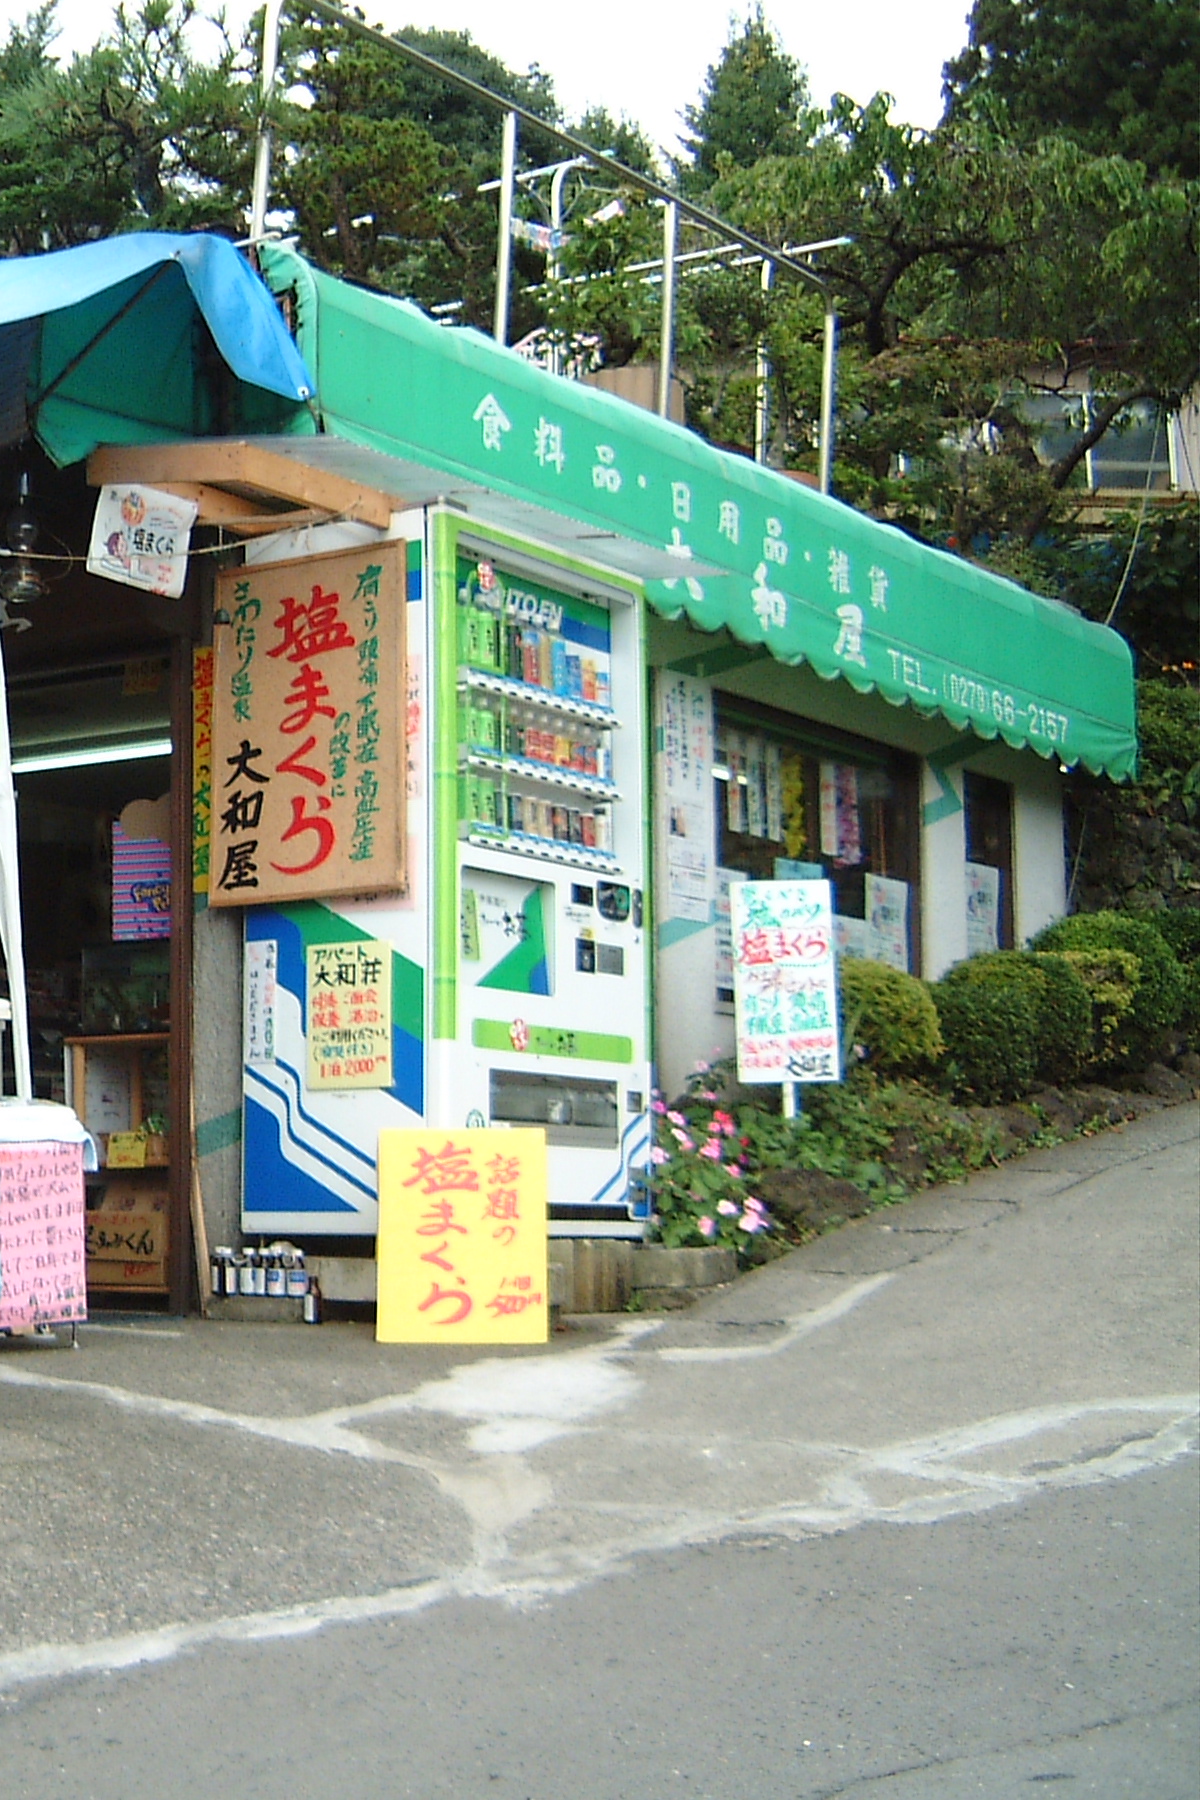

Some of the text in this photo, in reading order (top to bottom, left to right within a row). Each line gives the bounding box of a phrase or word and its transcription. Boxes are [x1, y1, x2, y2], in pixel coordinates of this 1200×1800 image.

[266, 585, 355, 876] 塩まくら
[217, 740, 270, 891] 大和屋
[312, 958, 382, 987] 大和荘
[314, 945, 367, 964] アパート
[739, 928, 828, 965] 塩まくら
[481, 1152, 521, 1246] 話題の
[403, 1141, 479, 1325] 塩まくら
[484, 1292, 543, 1319] 500円
